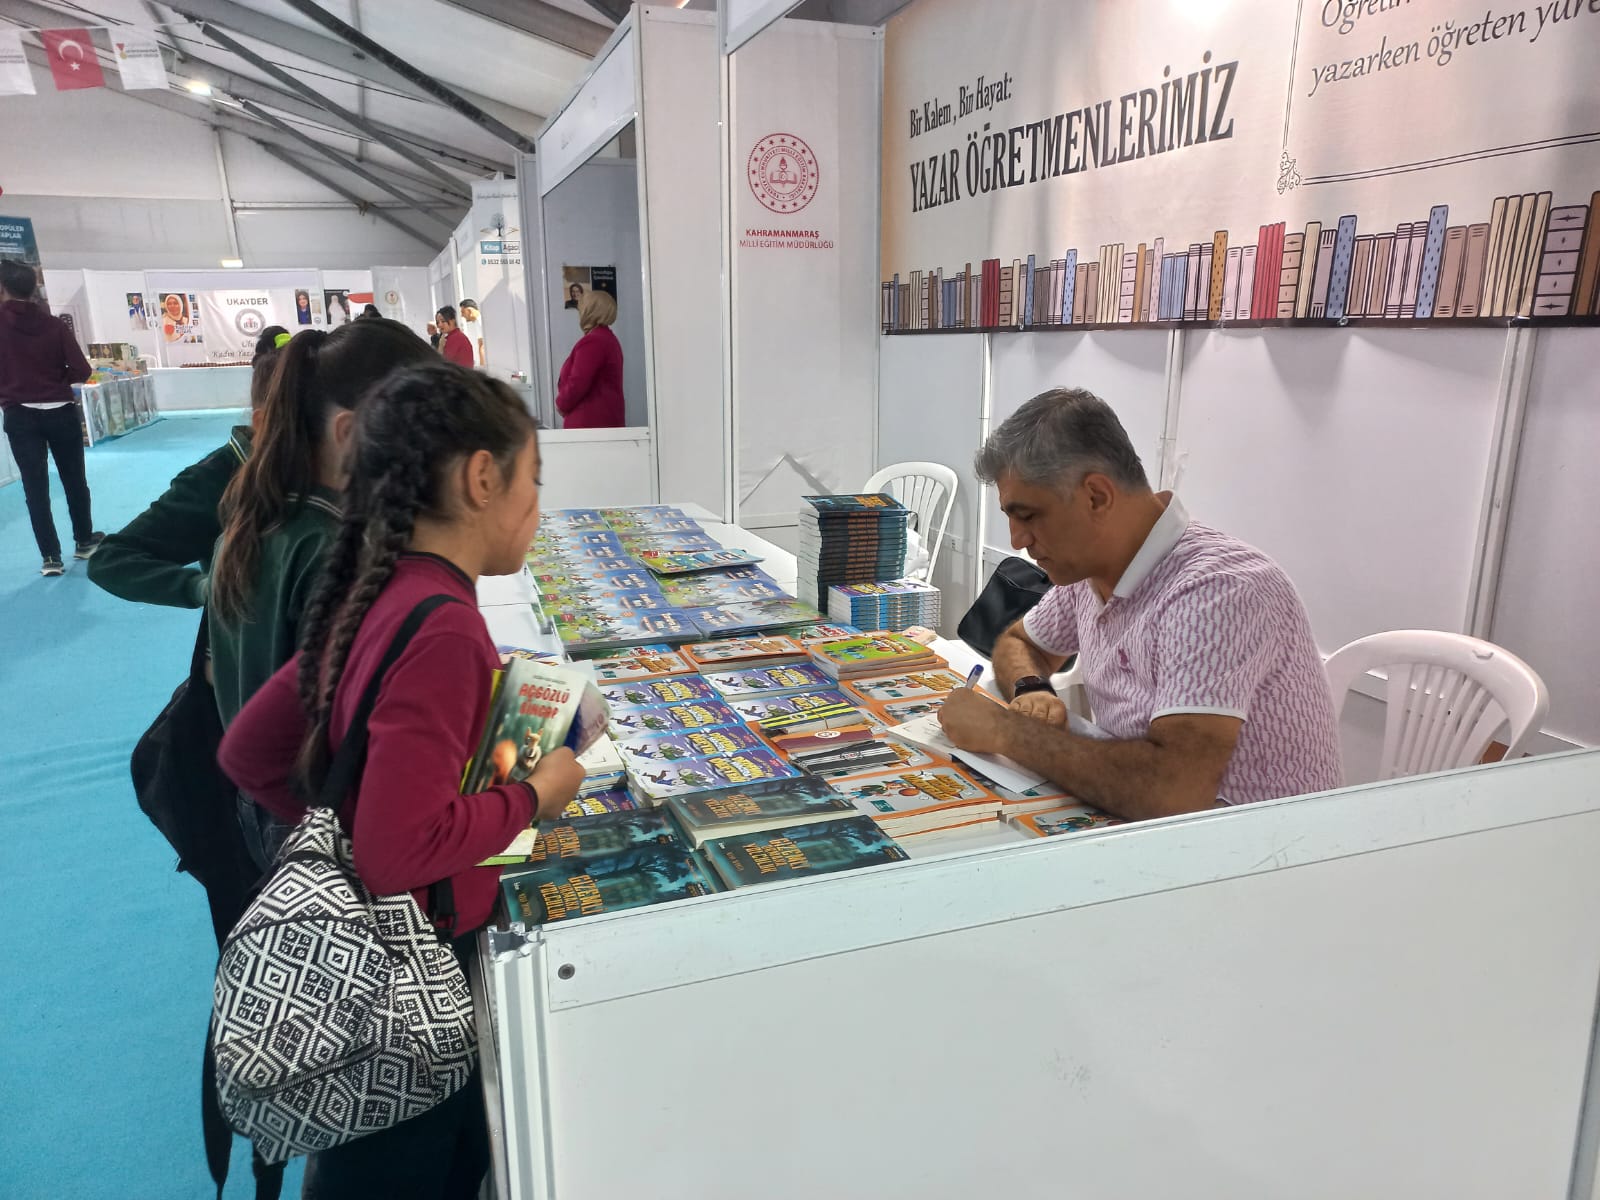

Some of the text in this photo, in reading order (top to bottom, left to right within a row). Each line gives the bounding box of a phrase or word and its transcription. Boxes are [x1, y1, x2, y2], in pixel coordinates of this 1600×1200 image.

[1308, 36, 1420, 97] yazarken
[1427, 10, 1526, 67] öğreten
[910, 108, 922, 139] Bir
[959, 85, 975, 118] Bin
[976, 72, 1012, 111] Hayat:
[910, 51, 1239, 213] YAZAR ÖĞRETMENLERİMİZ
[746, 229, 820, 239] KAHRAMANMARAŞ
[226, 297, 269, 305] UKAYDER
[518, 683, 570, 703] AÇGÖZLÜ
[768, 837, 815, 870] GİZEMLİ
[538, 882, 567, 921] YOLCULUK
[568, 874, 608, 915] GİZEMLİ
